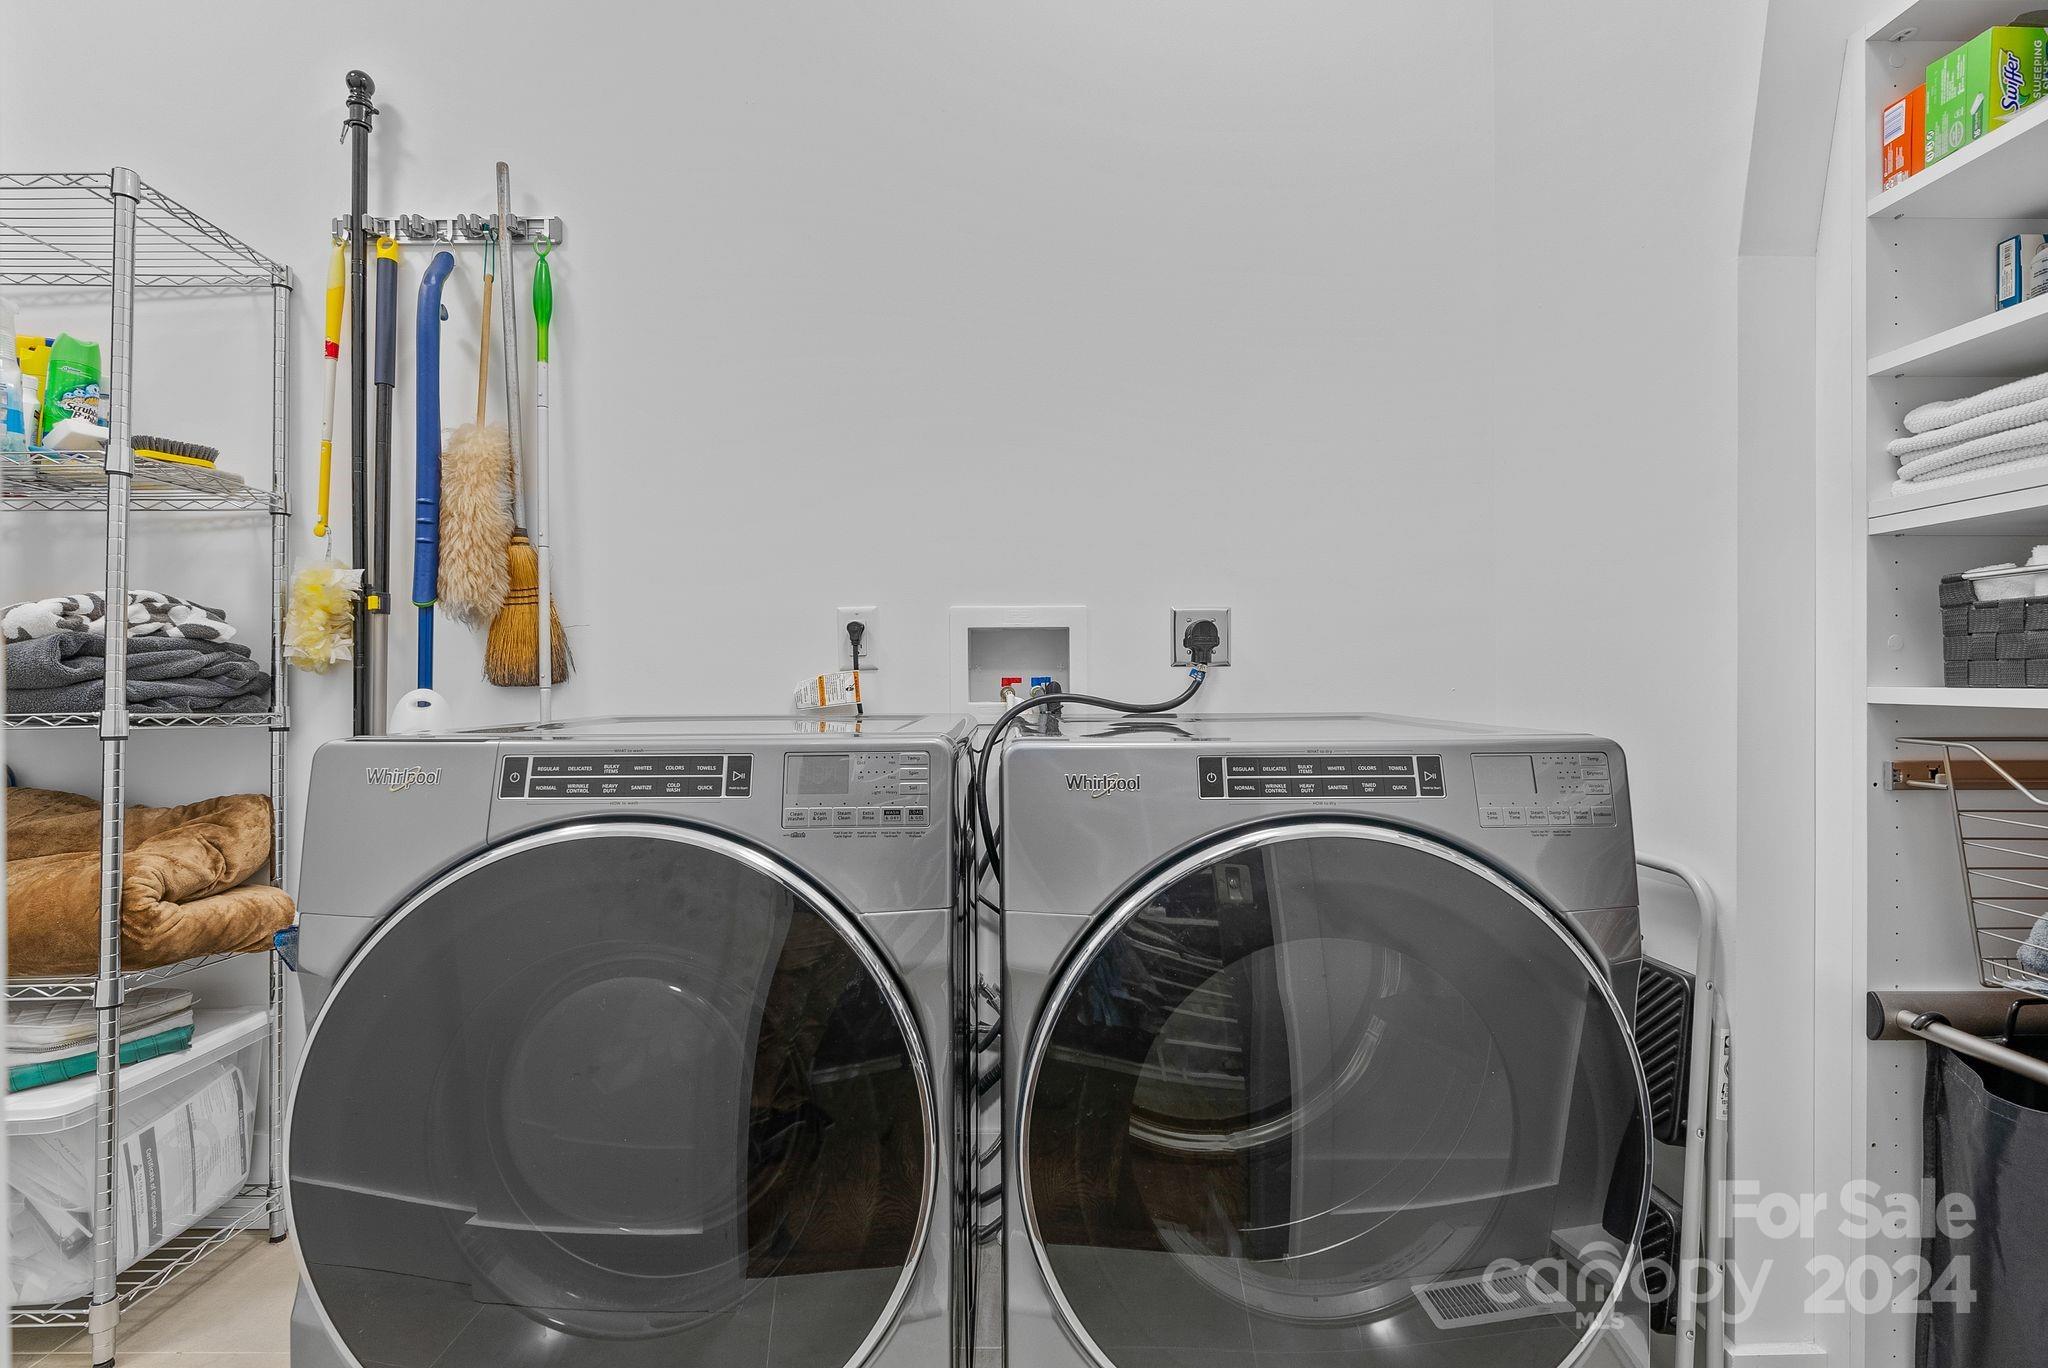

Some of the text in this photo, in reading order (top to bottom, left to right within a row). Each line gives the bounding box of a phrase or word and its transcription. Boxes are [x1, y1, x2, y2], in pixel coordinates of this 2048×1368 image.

[2001, 51, 2024, 112] Swiffer
[2034, 40, 2042, 98] SWEEPING
[366, 765, 442, 792] Whirlpool
[1064, 772, 1142, 798] Whirlpool
[145, 1147, 155, 1182] Certificate
